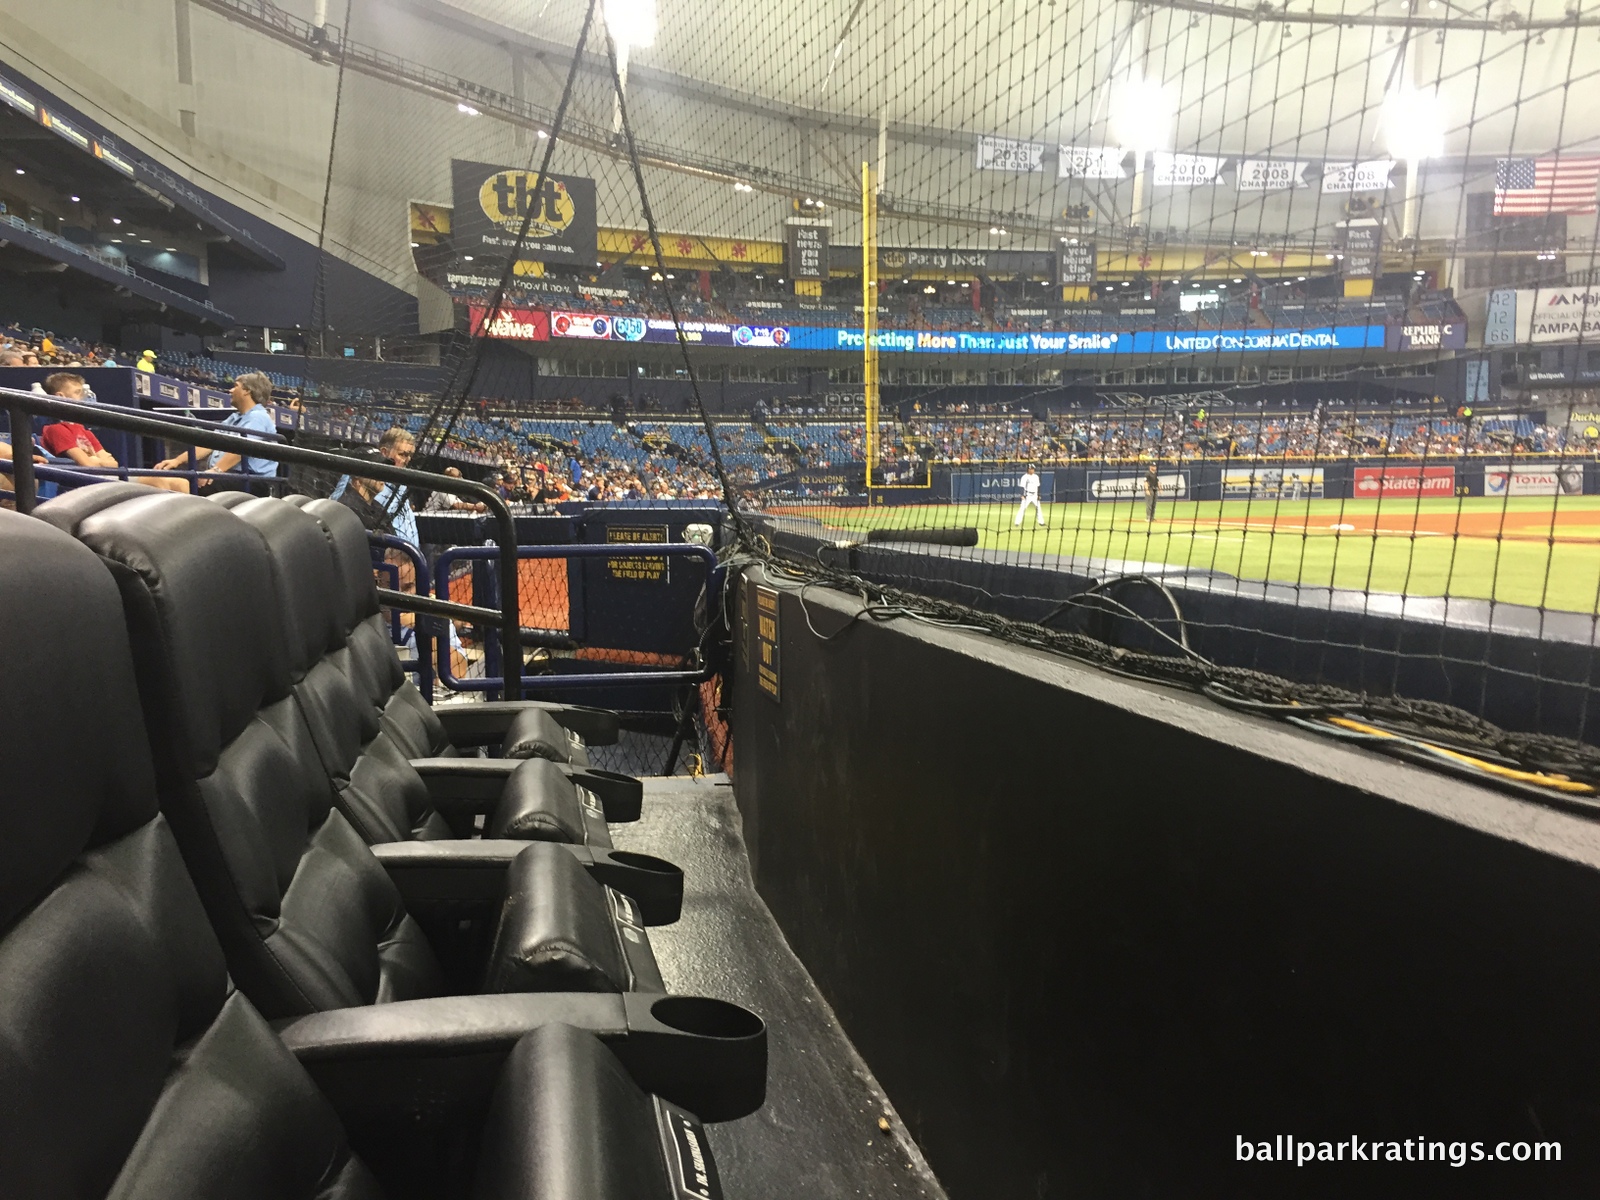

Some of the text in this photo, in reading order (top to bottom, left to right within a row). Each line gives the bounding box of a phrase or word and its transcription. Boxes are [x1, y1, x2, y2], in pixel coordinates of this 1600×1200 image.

[993, 148, 1028, 162] 2013
[1011, 162, 1036, 170] CARD
[1170, 164, 1206, 176] 2010
[1252, 169, 1289, 180] 2008
[1338, 171, 1375, 182] 2008
[1327, 182, 1385, 190] CHAMPIONS
[492, 174, 564, 222] tbt
[798, 229, 818, 240] Fast
[1348, 230, 1371, 240] Fast
[525, 241, 541, 251] you
[797, 240, 822, 249] news
[801, 249, 819, 260] you
[1068, 247, 1087, 256] you
[801, 258, 819, 267] can
[952, 253, 986, 267] Deck
[1062, 255, 1092, 265] heard
[1351, 256, 1371, 267] can
[1069, 264, 1087, 273] the
[1492, 293, 1510, 305] 42
[1572, 292, 1600, 307] Maj
[1493, 311, 1508, 323] 12
[1533, 311, 1570, 321] OFFICIAL
[1401, 324, 1453, 336] REPUBLC
[1532, 321, 1579, 334] TAMPA
[918, 332, 956, 349] More
[958, 333, 995, 349] Than
[998, 334, 1028, 349] Just
[1030, 333, 1065, 349] Your
[1166, 335, 1214, 350] UNITED
[1289, 332, 1340, 348] DENTAL
[1411, 334, 1441, 345] BANK
[1490, 329, 1509, 342] 66
[1514, 474, 1556, 484] TOTAL
[1456, 486, 1470, 495] 30
[609, 531, 631, 541] PLEASE
[612, 569, 622, 578] THE
[646, 570, 660, 580] PLAY
